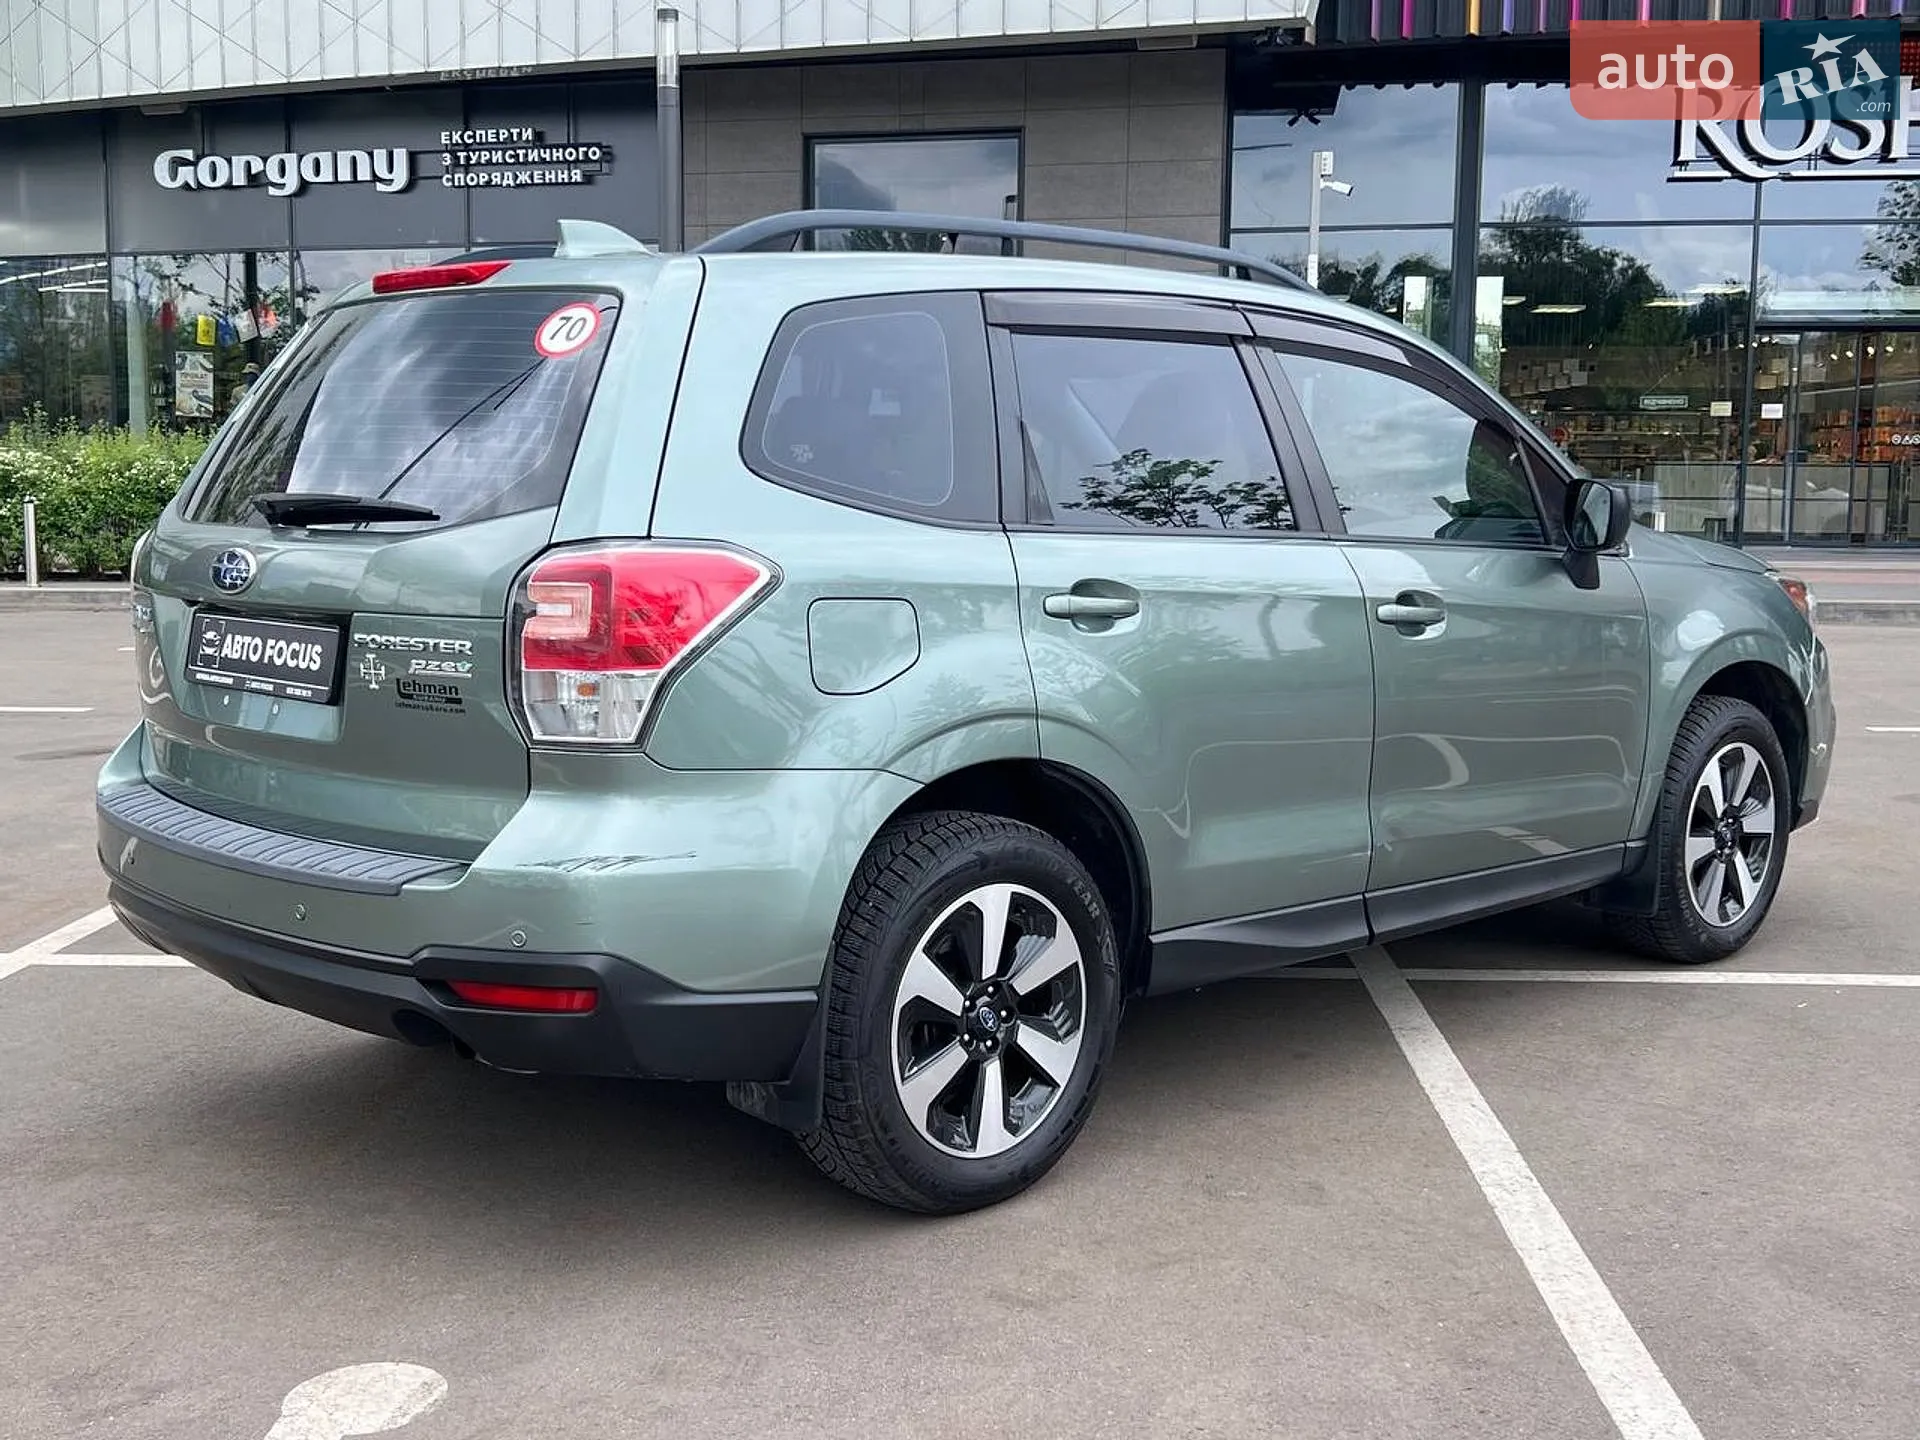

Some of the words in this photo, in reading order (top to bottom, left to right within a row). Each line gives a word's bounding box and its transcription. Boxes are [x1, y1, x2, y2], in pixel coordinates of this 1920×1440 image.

[440, 127, 533, 145] ЕКСПЕРТИ
[457, 146, 601, 165] ТУРИСТИЧНОГО
[153, 149, 409, 196] Gorgany
[442, 169, 582, 188] СПОРЯДЖЕННЯ
[550, 316, 588, 342] 70
[263, 638, 322, 671] FOCUS
[353, 633, 473, 656] FORESTER
[396, 677, 459, 698] Lehman
